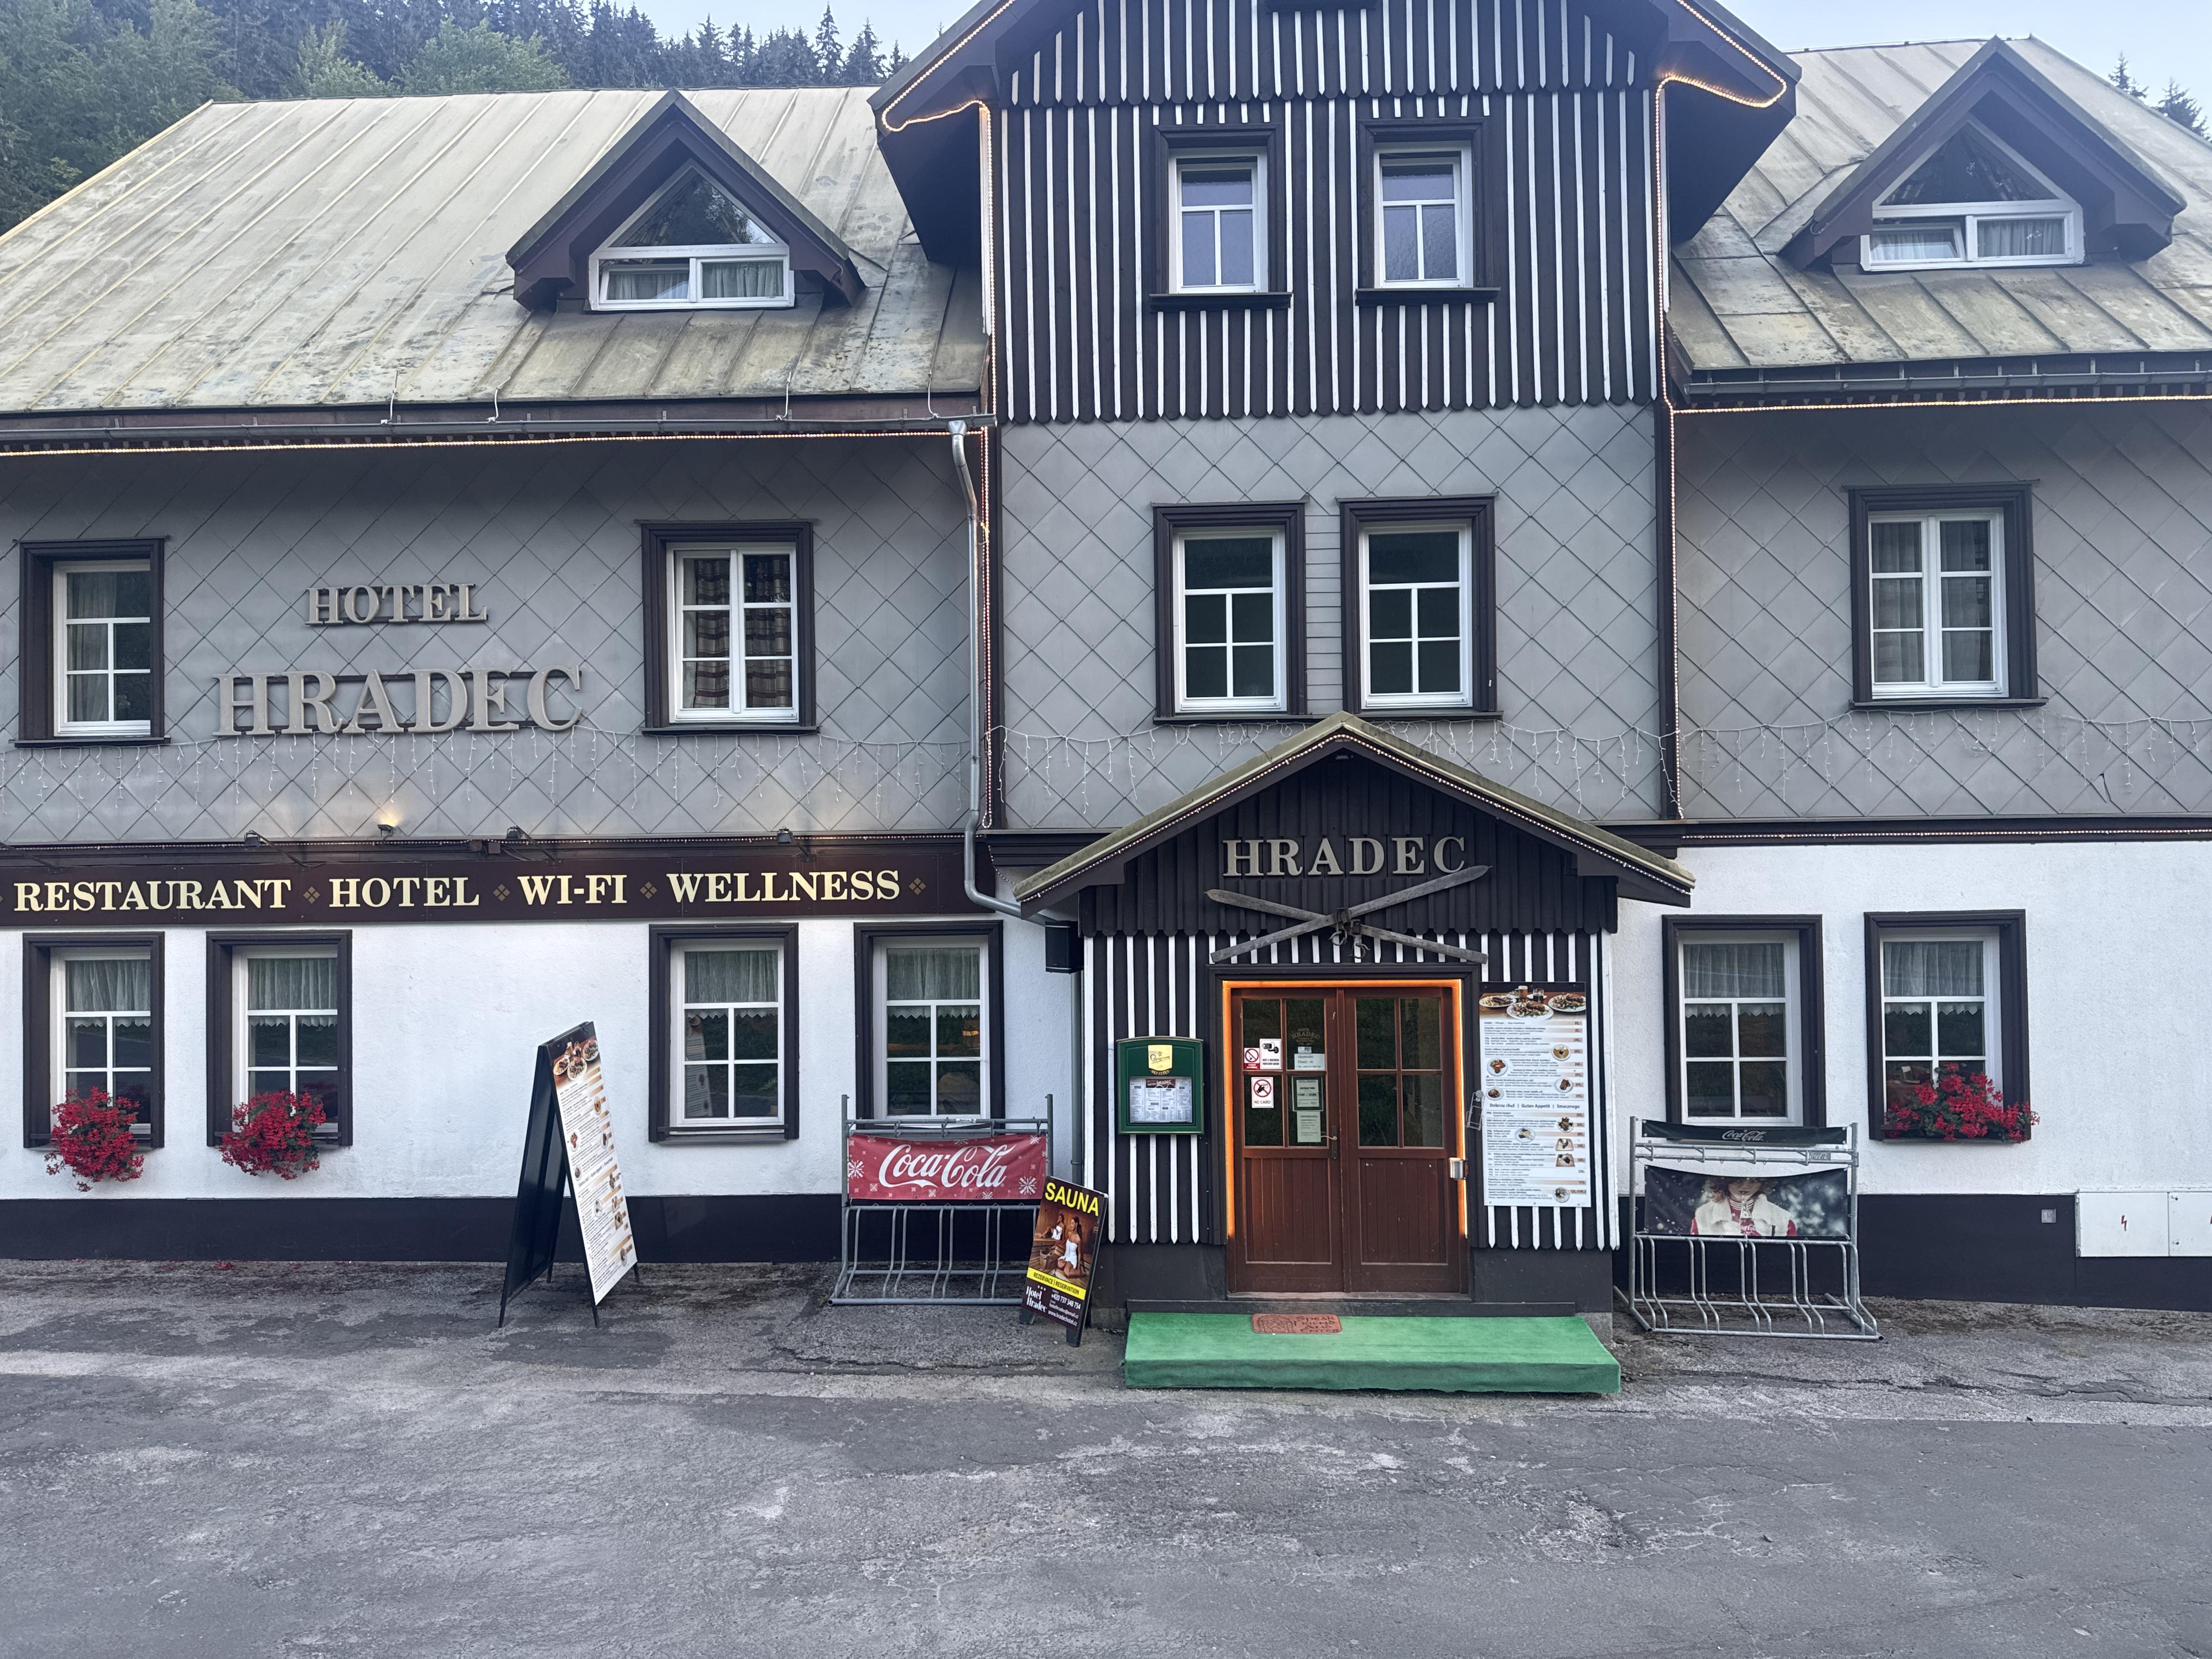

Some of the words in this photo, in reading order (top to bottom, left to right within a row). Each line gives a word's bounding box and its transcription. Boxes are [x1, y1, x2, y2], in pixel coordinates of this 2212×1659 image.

[305, 583, 488, 625] HOTEL
[212, 664, 582, 736] HRADEC
[1223, 837, 1465, 877] HRADEC
[14, 879, 291, 911] RESTAURANT
[329, 877, 479, 909] HOTEL
[517, 875, 627, 905] WI-FI
[666, 870, 900, 903] WELLNESS
[1721, 1130, 1767, 1141] Coca-Cola
[878, 1144, 1016, 1188] Coca-Cola
[1045, 1182, 1099, 1217] SAUNA
[1026, 1286, 1042, 1300] Hotel
[1034, 1272, 1053, 1285] REZERVACE
[1055, 1281, 1080, 1295] RESERVATION
[1026, 1296, 1046, 1312] Hradec
